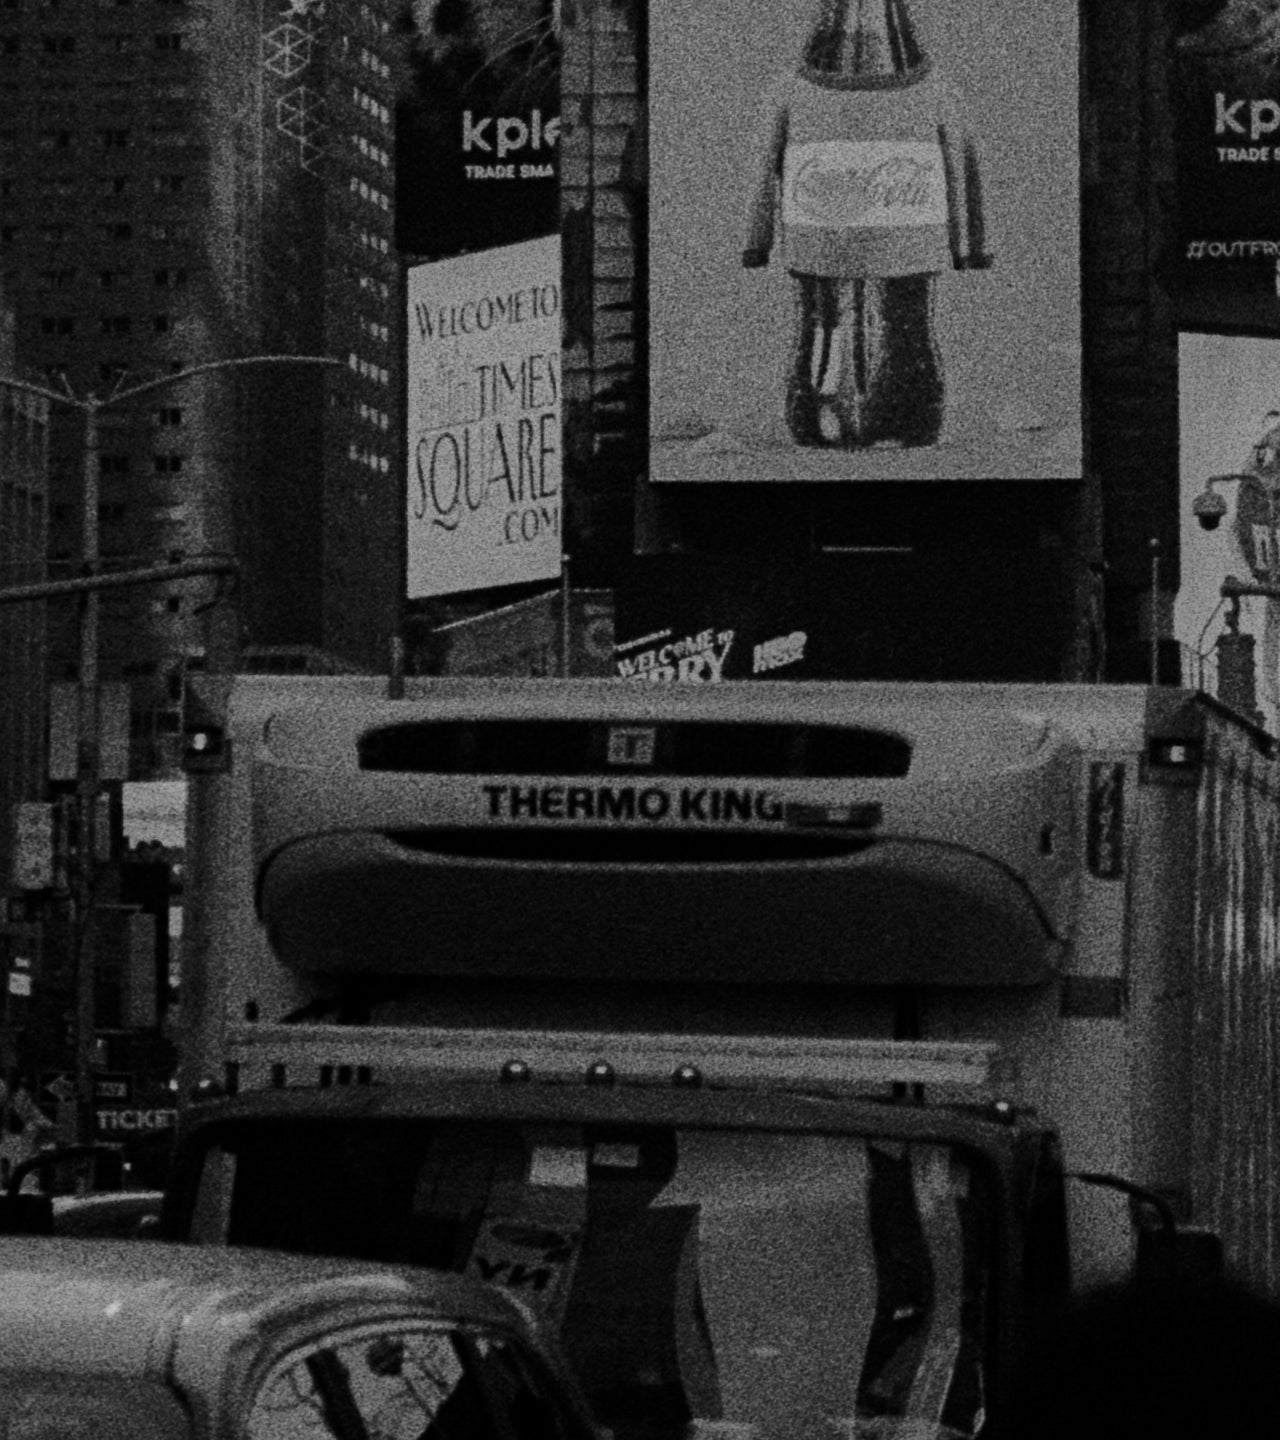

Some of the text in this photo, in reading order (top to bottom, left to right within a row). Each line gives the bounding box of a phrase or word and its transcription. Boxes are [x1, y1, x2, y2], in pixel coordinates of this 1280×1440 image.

[464, 163, 516, 179] TRADE
[1217, 147, 1269, 162] TRADE
[415, 283, 559, 340] WELCOME TO
[475, 352, 558, 420] TIMES
[414, 413, 558, 531] SQUARE
[483, 785, 784, 822] THERMO KING
